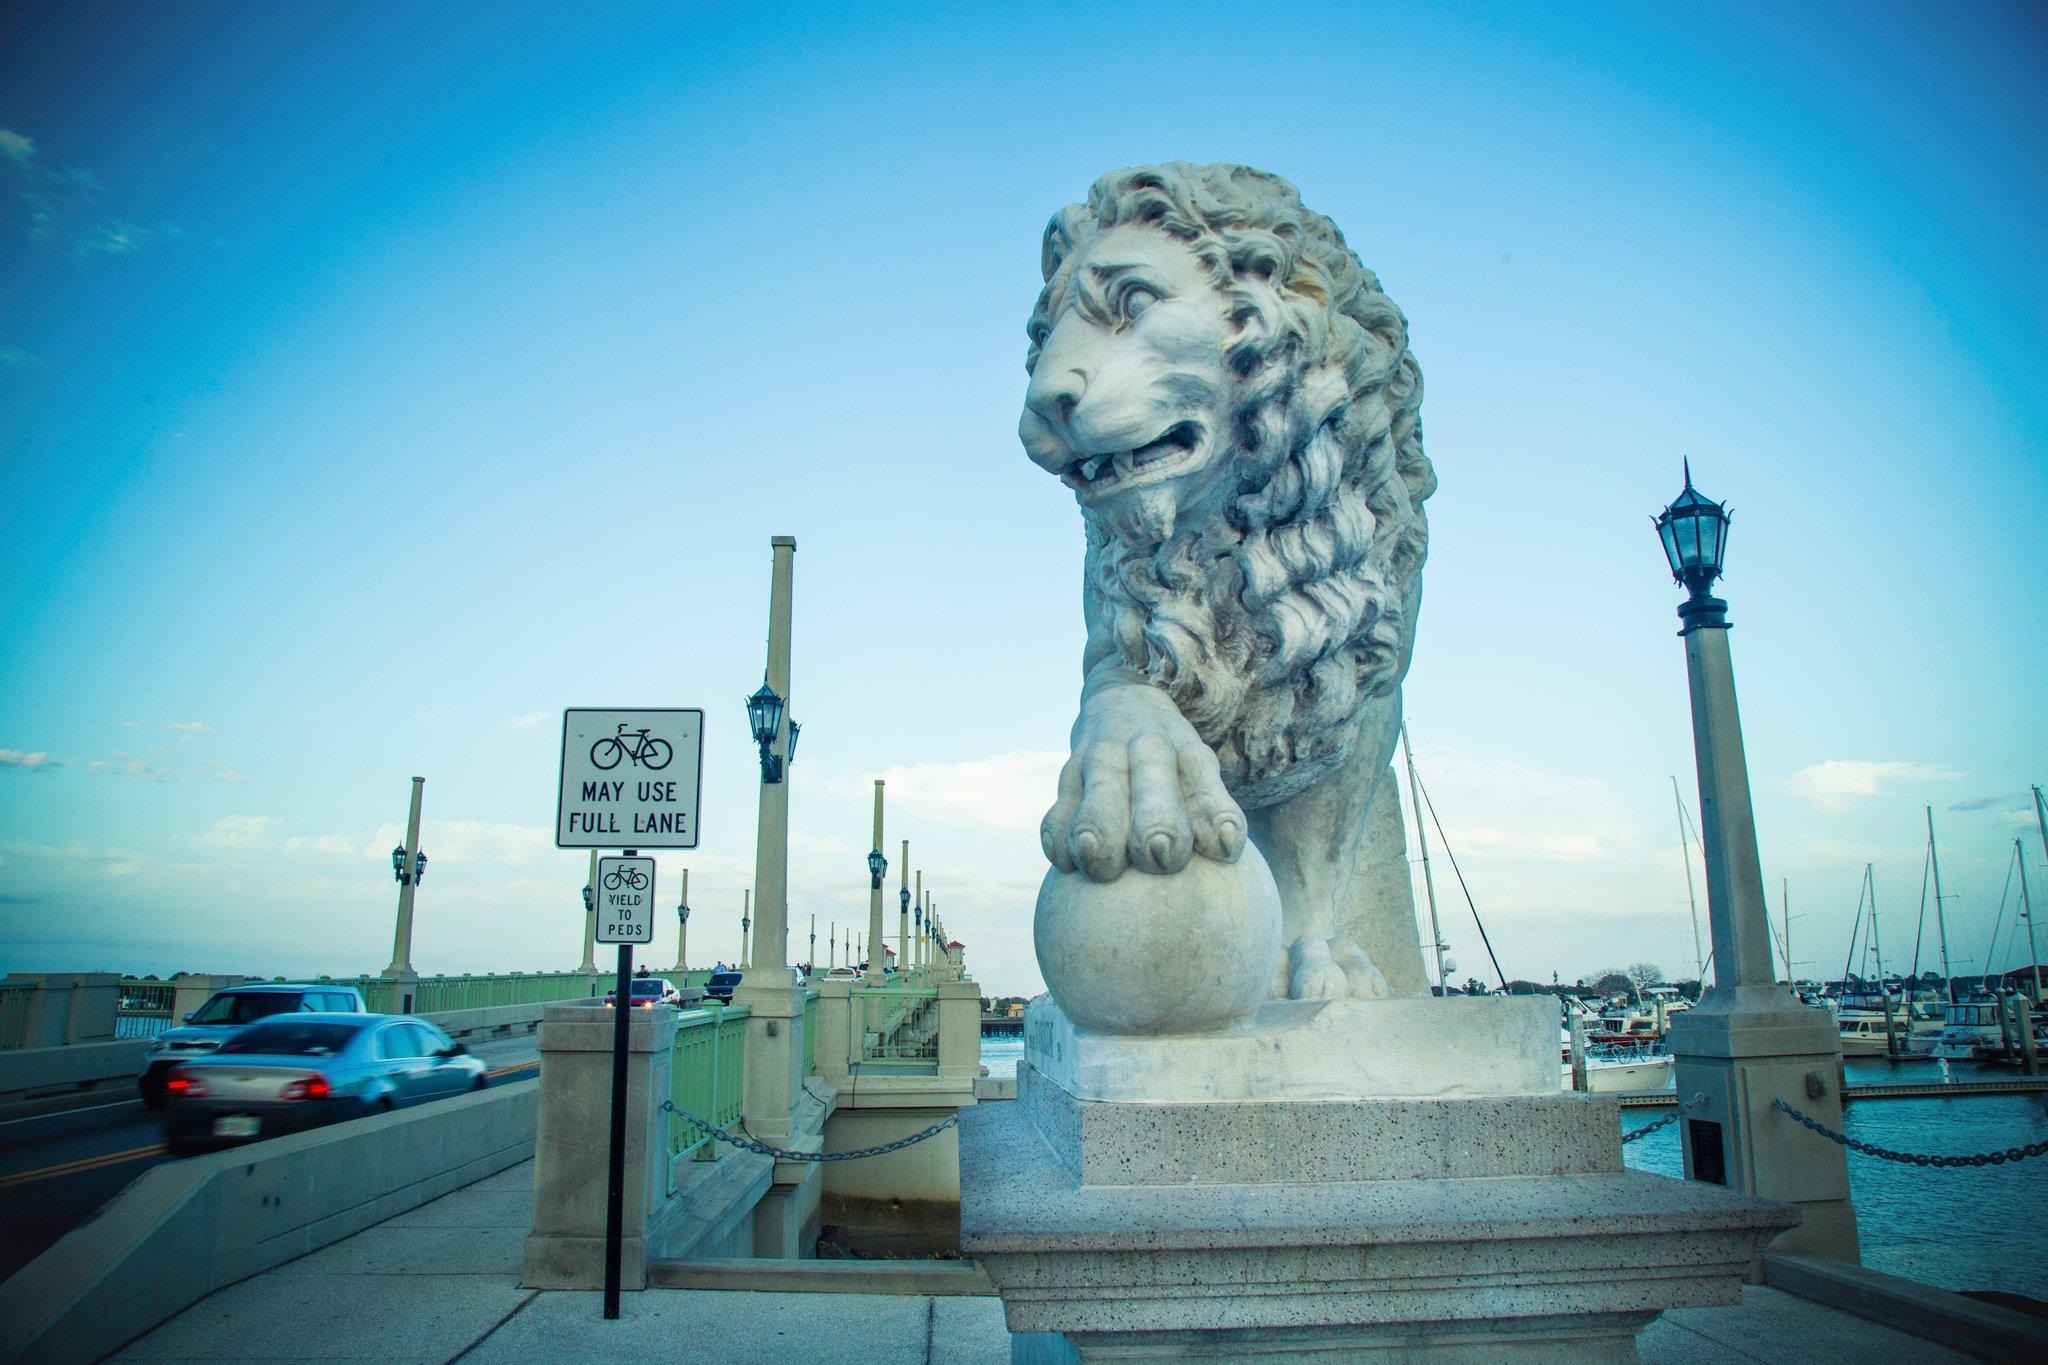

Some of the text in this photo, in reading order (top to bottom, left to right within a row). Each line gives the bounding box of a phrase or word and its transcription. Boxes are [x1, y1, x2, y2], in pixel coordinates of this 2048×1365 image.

[581, 781, 677, 802] MAY USE
[569, 812, 686, 833] FULL LANE
[609, 894, 643, 906] YIELD
[618, 909, 632, 921] TO
[608, 924, 642, 936] PEDS
